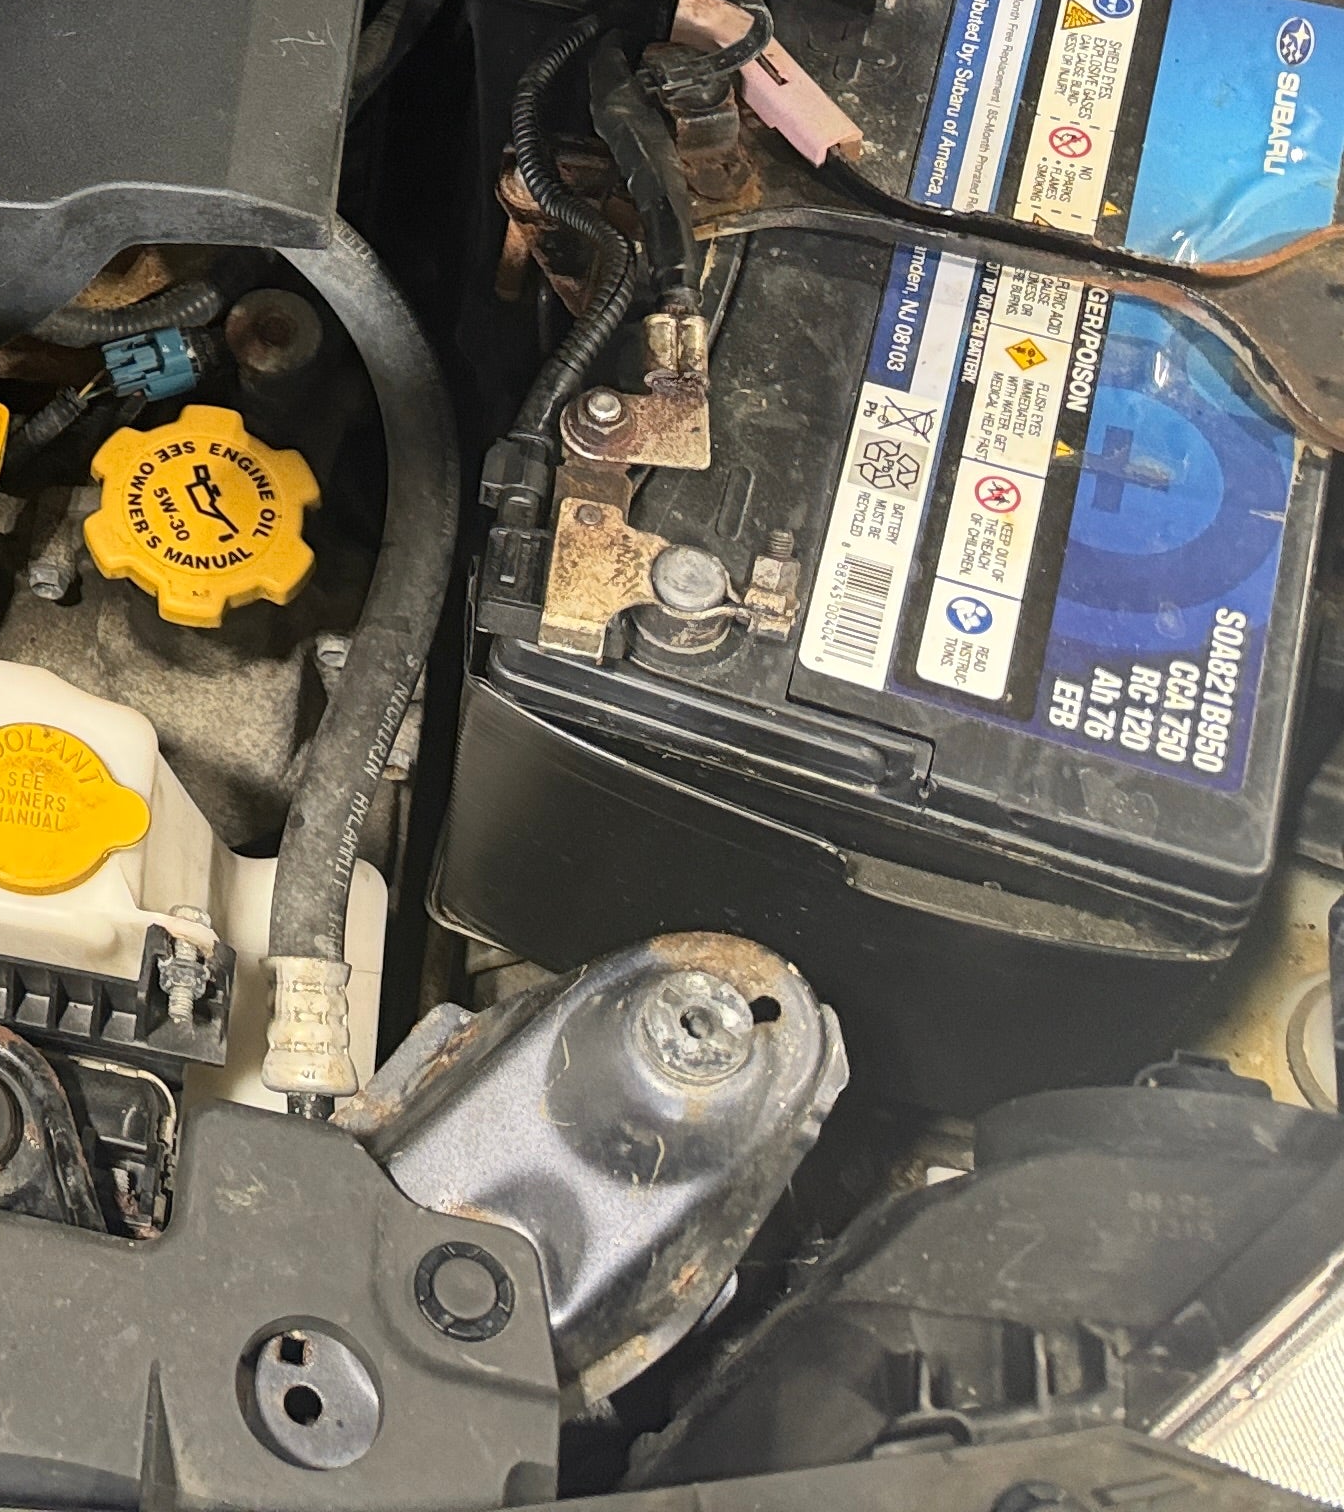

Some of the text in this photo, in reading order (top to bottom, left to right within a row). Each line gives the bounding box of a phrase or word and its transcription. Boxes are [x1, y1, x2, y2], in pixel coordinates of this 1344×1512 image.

[1003, 21, 1018, 43] Free
[1062, 31, 1078, 53] NESS
[1077, 33, 1091, 50] CAN
[954, 42, 978, 66] by:
[989, 43, 1013, 103] Replacement
[1059, 53, 1073, 66] OR
[1071, 51, 1087, 78] CAUSE
[1102, 39, 1122, 74] SHIELD
[945, 66, 972, 118] Subaru
[1077, 36, 1107, 120] EXPLOSIVE GASES
[941, 118, 957, 135] of
[1261, 70, 1300, 176] SUBARU
[924, 135, 954, 199] America,
[968, 153, 988, 195] Prorated
[1029, 162, 1046, 202] SMOKING
[1044, 165, 1061, 200] FLAMES
[1058, 169, 1075, 203] SPARKS
[1078, 165, 1093, 180] NO
[976, 292, 992, 309] OR
[979, 275, 996, 293] TIP
[1036, 277, 1053, 306] CAUSE
[896, 298, 919, 322] NJ
[970, 308, 989, 338] OPEN
[1020, 303, 1032, 316] OR
[1046, 310, 1062, 335] ACID
[885, 322, 913, 372] 08103
[959, 338, 983, 385] BATTERY.
[1064, 286, 1108, 413] GER/POISON
[984, 370, 1003, 410] MEDICAL
[1003, 375, 1018, 398] WITH
[862, 399, 877, 419] Pb
[979, 411, 995, 436] HELP
[1011, 378, 1033, 438] IMMEDIATELY
[1027, 382, 1049, 437] FLUSH EYES
[992, 433, 1007, 452] GET
[881, 457, 894, 473] Pb
[127, 440, 254, 570] SEE OWNER'S MANUAL
[208, 442, 276, 539] ENGINE OIL
[152, 486, 191, 542] 5W-30
[849, 490, 869, 537] RECYCLED
[867, 498, 886, 539] MUST BE
[885, 502, 904, 544] BATTERY
[969, 512, 982, 525] OF
[976, 517, 998, 570] THE REACH
[990, 520, 1014, 583] KEEP OUT OF
[828, 561, 848, 600] 88745
[820, 603, 838, 642] 00404
[952, 639, 973, 686] INSTRUC-
[973, 645, 989, 672] READ
[1047, 678, 1084, 730] EFB
[1082, 666, 1123, 741] Ah 76
[1118, 664, 1162, 752] RC 120
[1154, 659, 1201, 763] CCA 750
[360, 680, 408, 780] NICHIRIN
[7, 771, 47, 791] SEE
